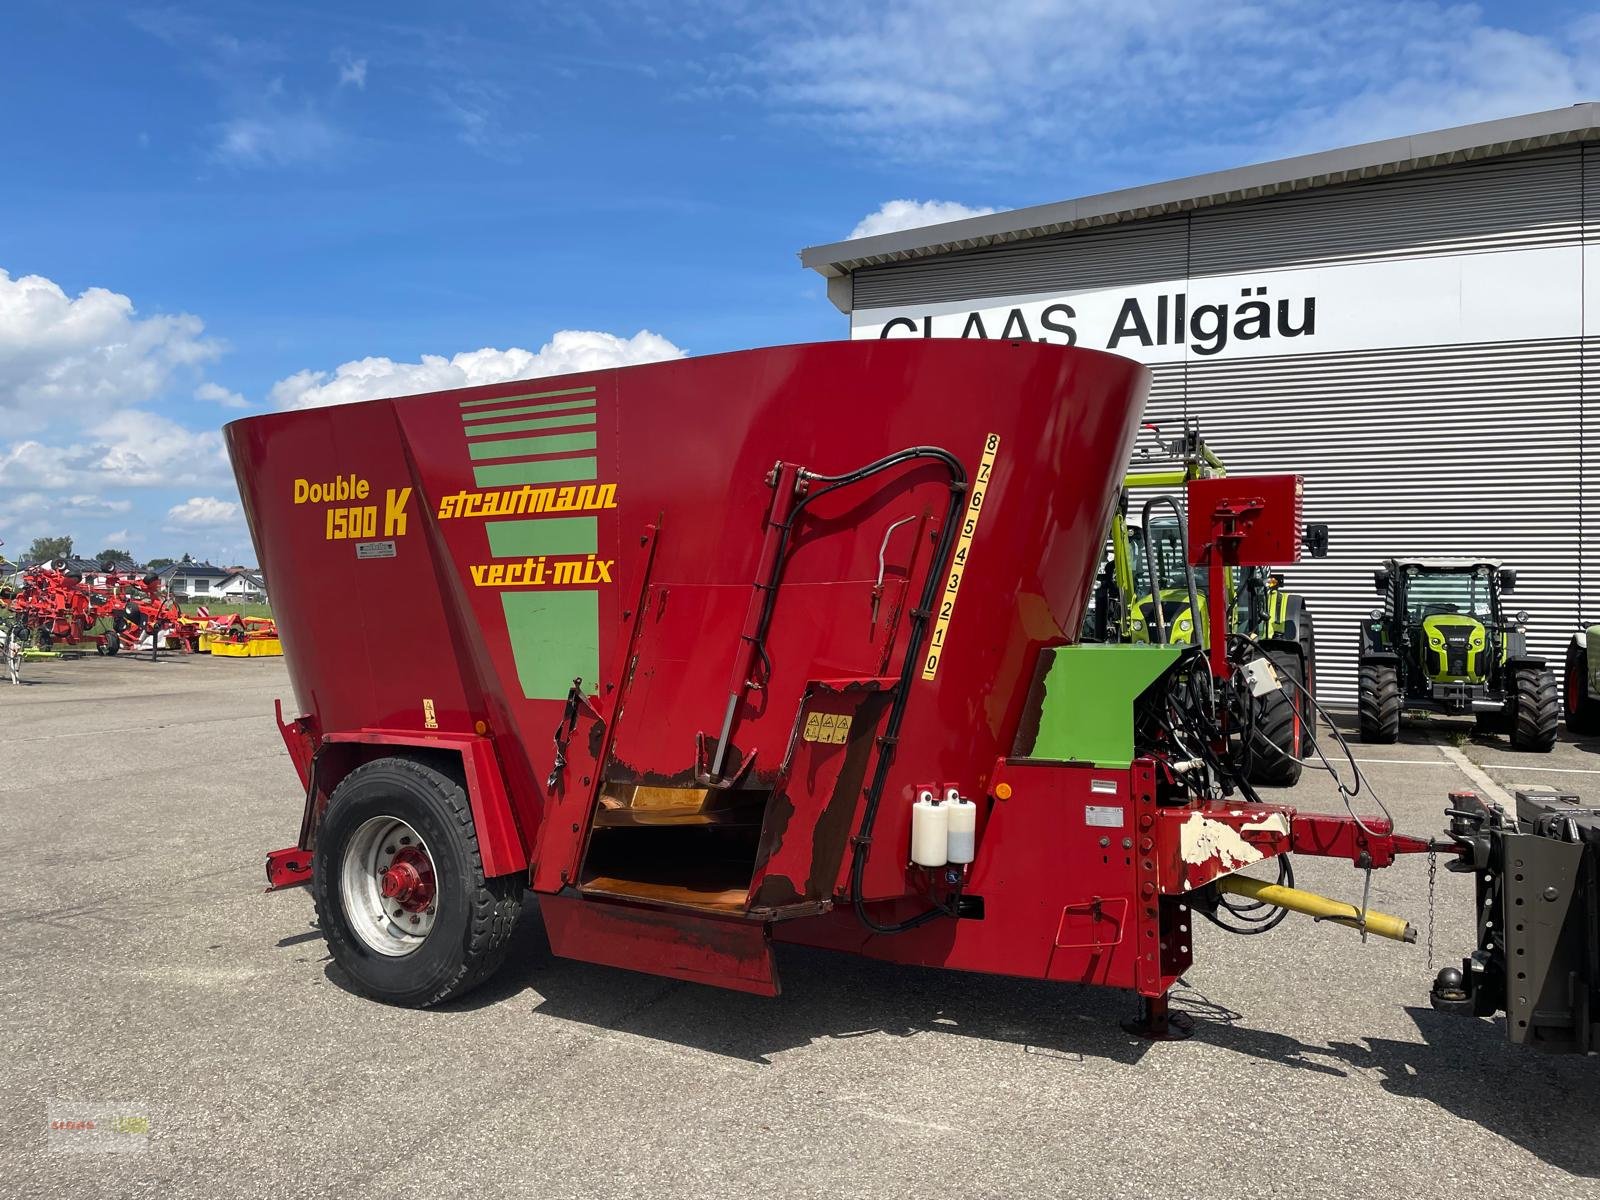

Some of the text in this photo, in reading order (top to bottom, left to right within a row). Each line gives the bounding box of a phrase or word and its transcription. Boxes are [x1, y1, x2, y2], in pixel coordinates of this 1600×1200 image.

[1106, 286, 1316, 356] Allgäu
[987, 434, 998, 450] 8
[982, 463, 991, 479] 7
[294, 474, 370, 504] Double
[438, 483, 618, 520] strautmann
[973, 491, 983, 507] 6
[326, 487, 413, 540] 1500 K
[964, 518, 975, 535] 5
[956, 547, 967, 562] 4
[469, 554, 615, 587] verti-mix
[949, 574, 959, 589] 3
[941, 602, 952, 617] 2
[935, 628, 943, 644] 1
[927, 655, 937, 670] 0
